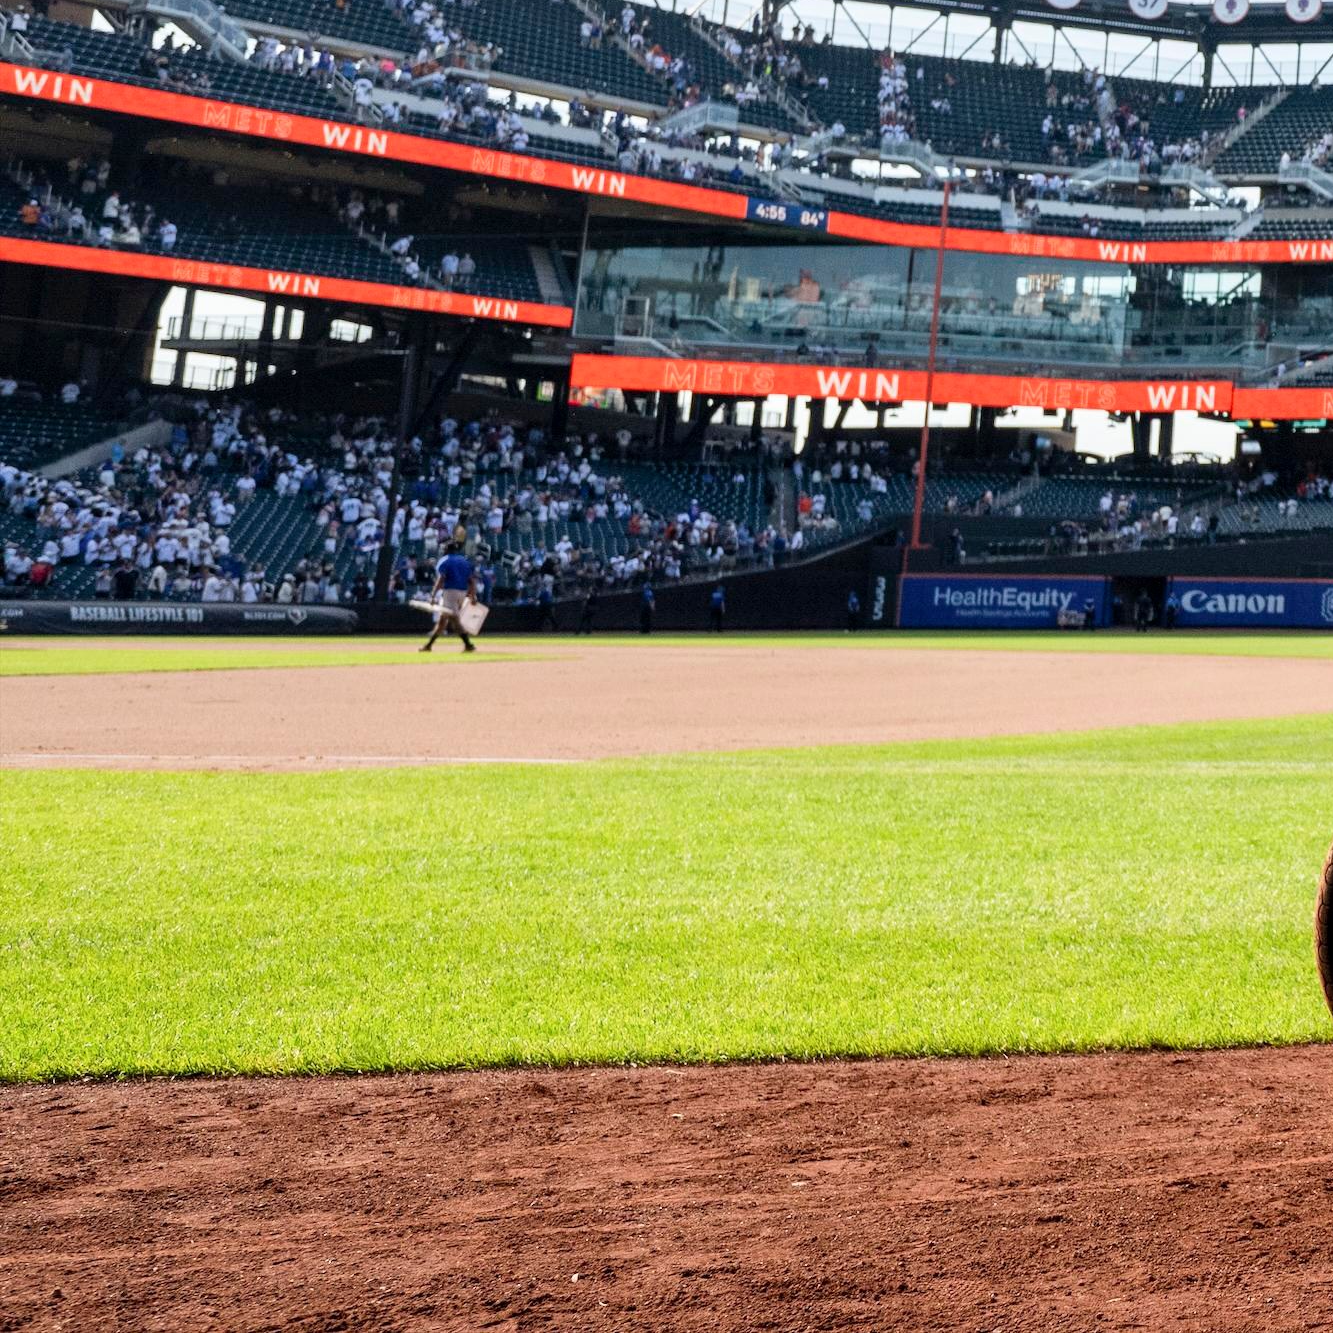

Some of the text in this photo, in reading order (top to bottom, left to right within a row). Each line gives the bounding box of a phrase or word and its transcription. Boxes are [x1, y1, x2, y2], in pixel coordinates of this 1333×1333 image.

[15, 69, 626, 196] WIN METS WIN METS WIN
[755, 203, 787, 221] 4:55
[1099, 242, 1147, 261] WIN
[268, 273, 320, 295] WIN
[473, 297, 518, 320] WIN
[663, 363, 1216, 410] METS WIN METS WIN
[934, 586, 1073, 609] HealthEquity
[1181, 589, 1284, 614] Canon
[70, 606, 127, 621] BASEBALL
[129, 607, 184, 622] LIFESTYLE
